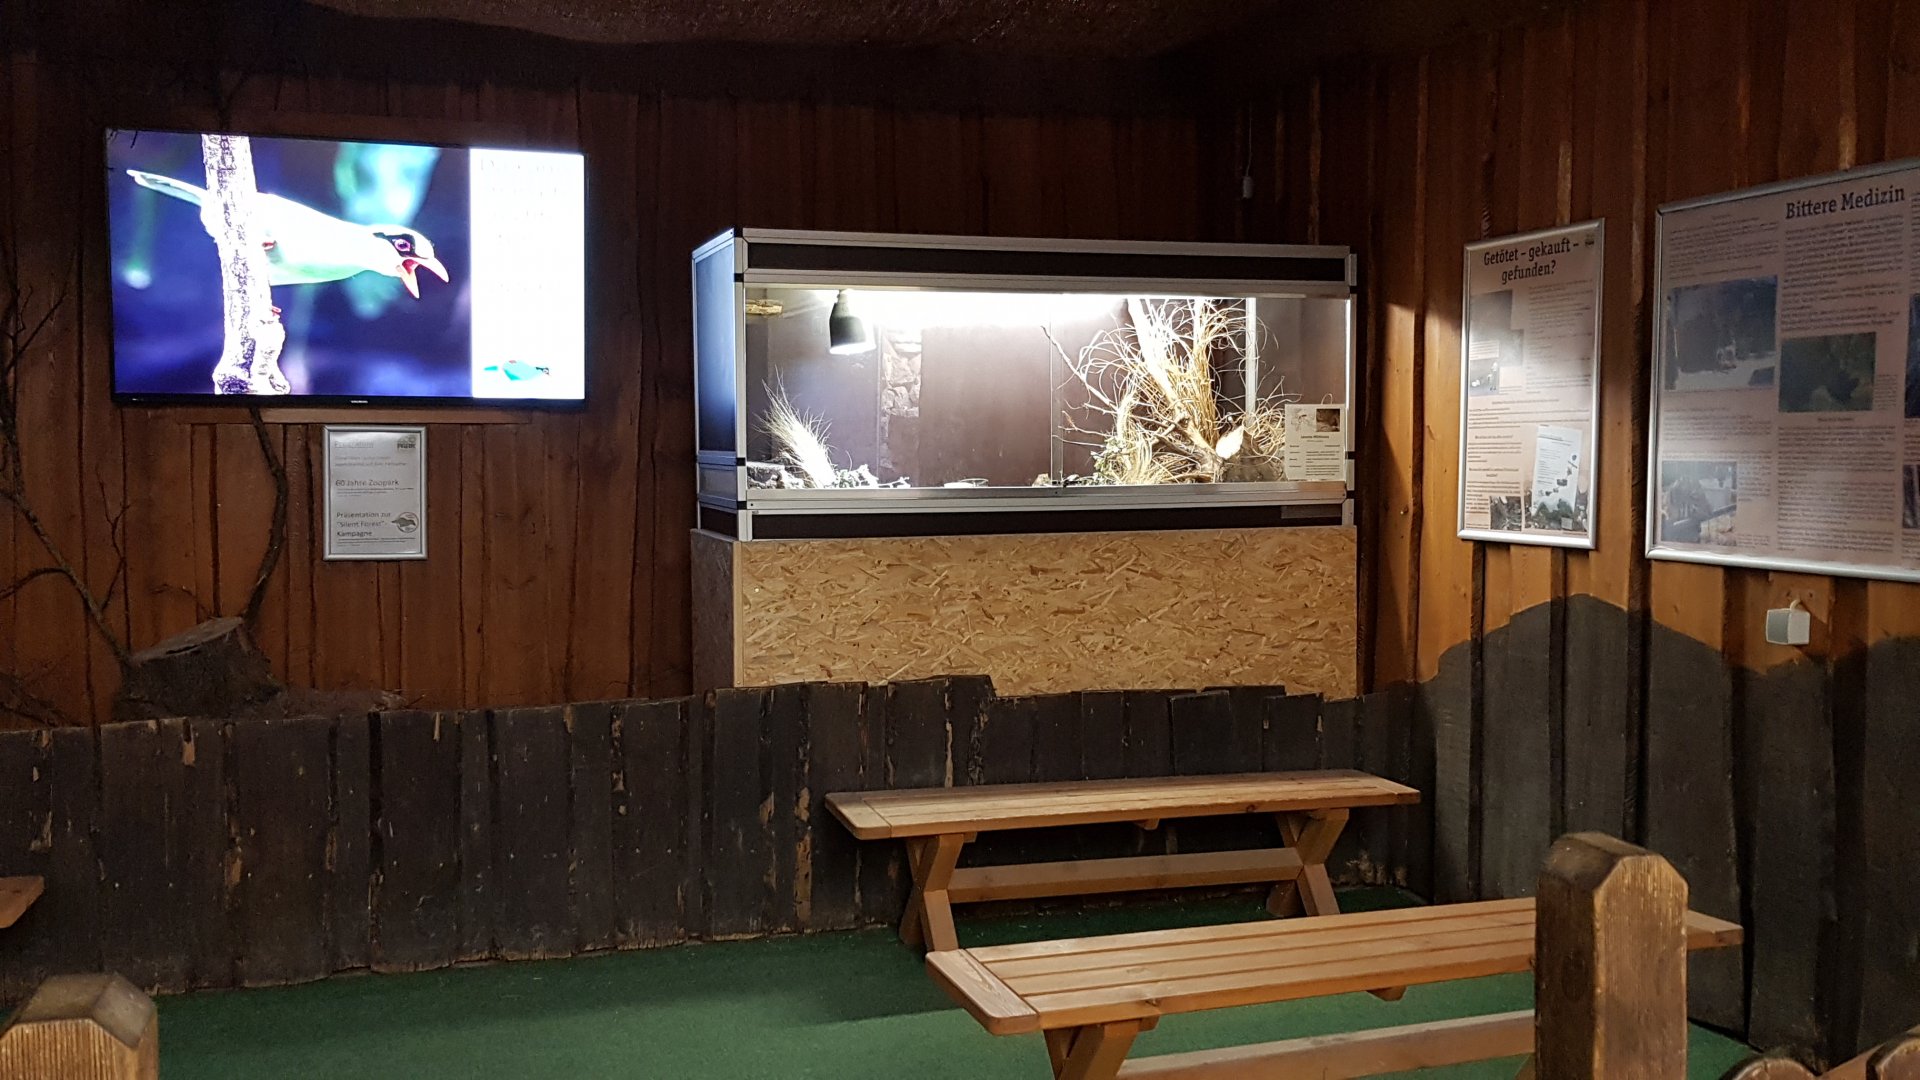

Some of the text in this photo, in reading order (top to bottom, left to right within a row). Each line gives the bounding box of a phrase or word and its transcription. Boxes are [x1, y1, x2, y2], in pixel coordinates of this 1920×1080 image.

[1785, 185, 1905, 220] Bittere Medizin
[1484, 248, 1519, 266] Getötet
[1529, 238, 1571, 262] gekauft
[1501, 260, 1556, 285] gefunden?
[347, 479, 367, 487] Jahre
[368, 478, 400, 487] Zoopark
[336, 511, 380, 519] Präsentation
